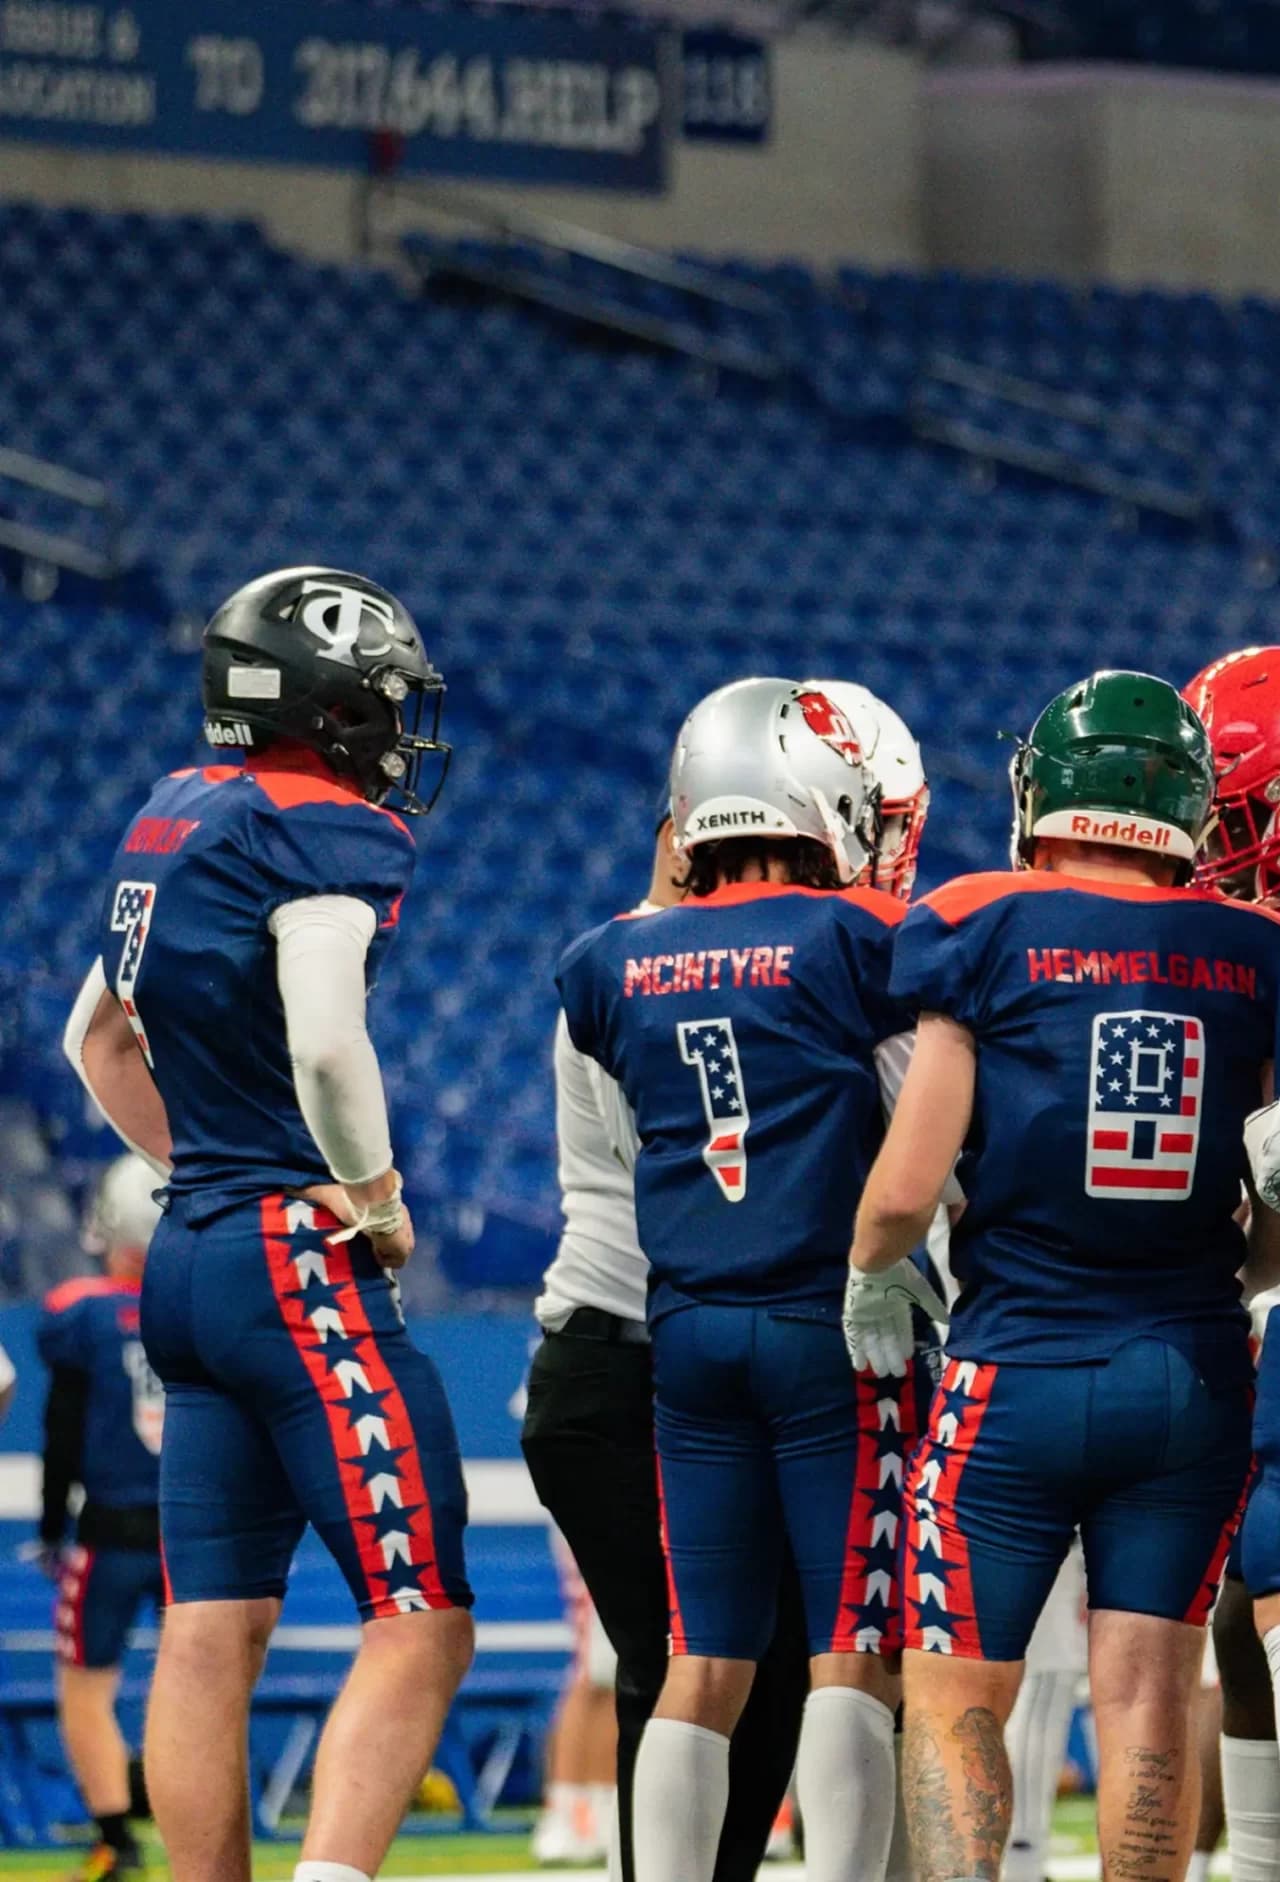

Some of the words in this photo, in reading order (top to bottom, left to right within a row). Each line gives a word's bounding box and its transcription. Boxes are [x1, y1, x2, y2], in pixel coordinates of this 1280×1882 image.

[187, 33, 264, 115] TO
[697, 811, 765, 831] XENITH
[1071, 815, 1171, 847] Riddell
[624, 945, 795, 998] MCINTYRE
[1027, 948, 1256, 1000] HEMMELGARN
[676, 1017, 750, 1203] 1
[1085, 1010, 1205, 1200] 8
